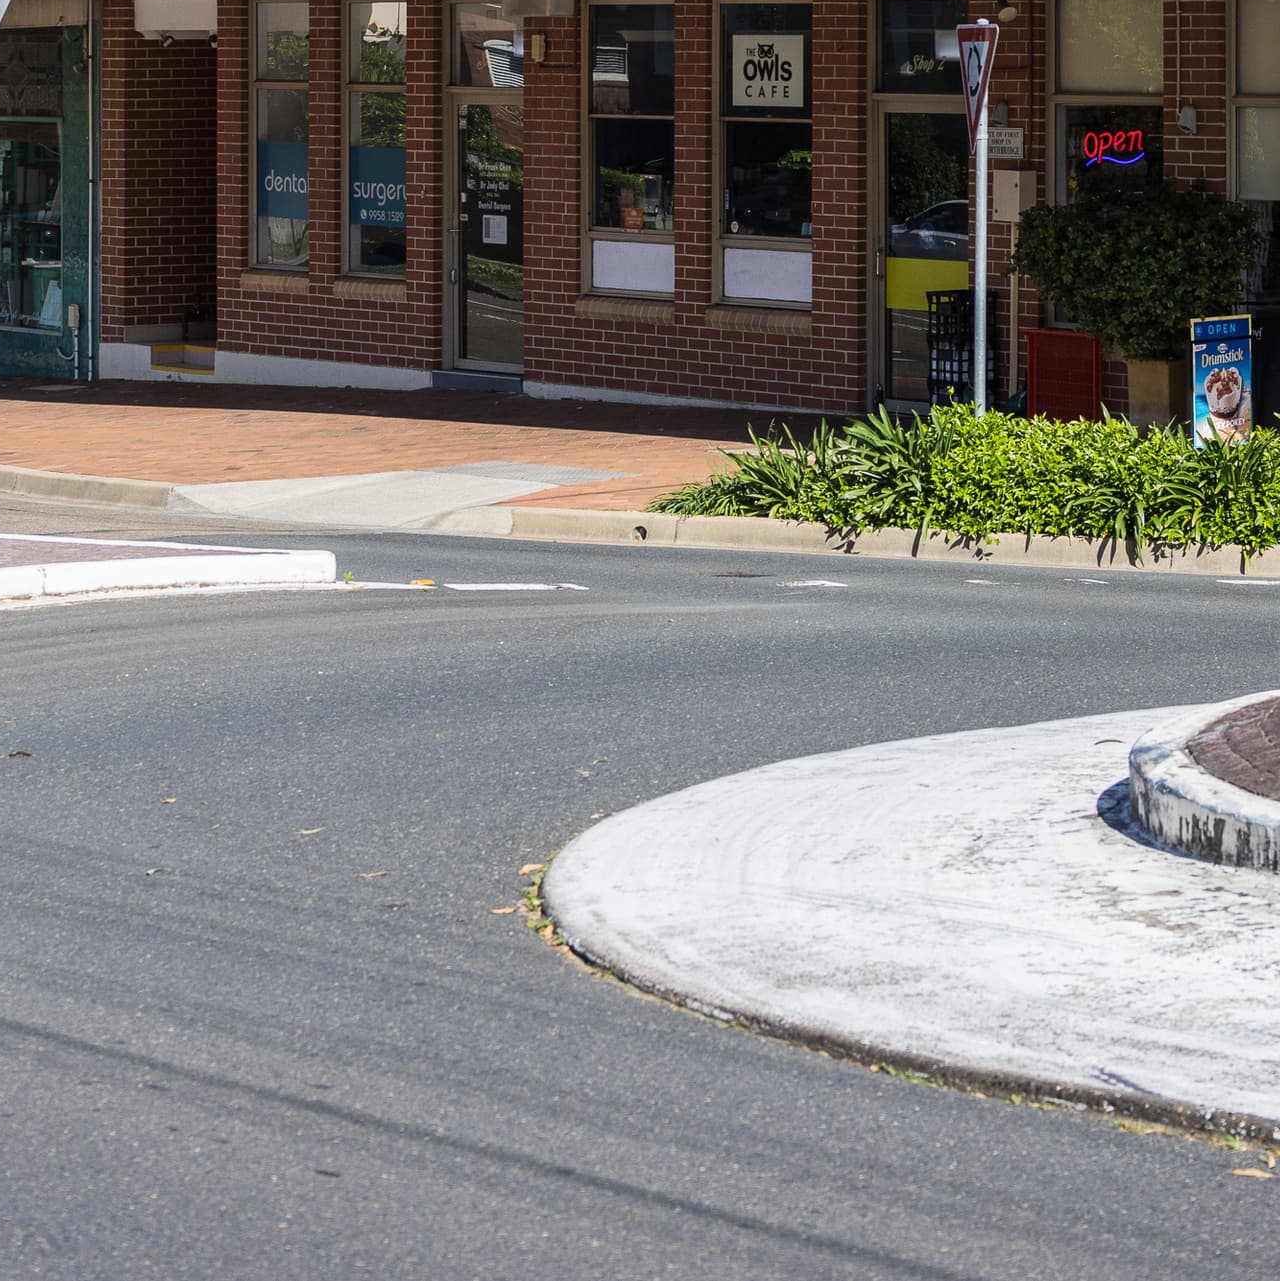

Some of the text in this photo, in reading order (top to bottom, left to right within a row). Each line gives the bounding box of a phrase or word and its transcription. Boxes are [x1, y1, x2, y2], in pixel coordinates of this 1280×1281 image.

[745, 47, 757, 57] THE
[906, 54, 936, 74] Shop
[744, 84, 790, 99] CAFE
[368, 209, 386, 222] 9958
[1207, 323, 1237, 335] OPEN
[1200, 348, 1245, 369] Drumstick
